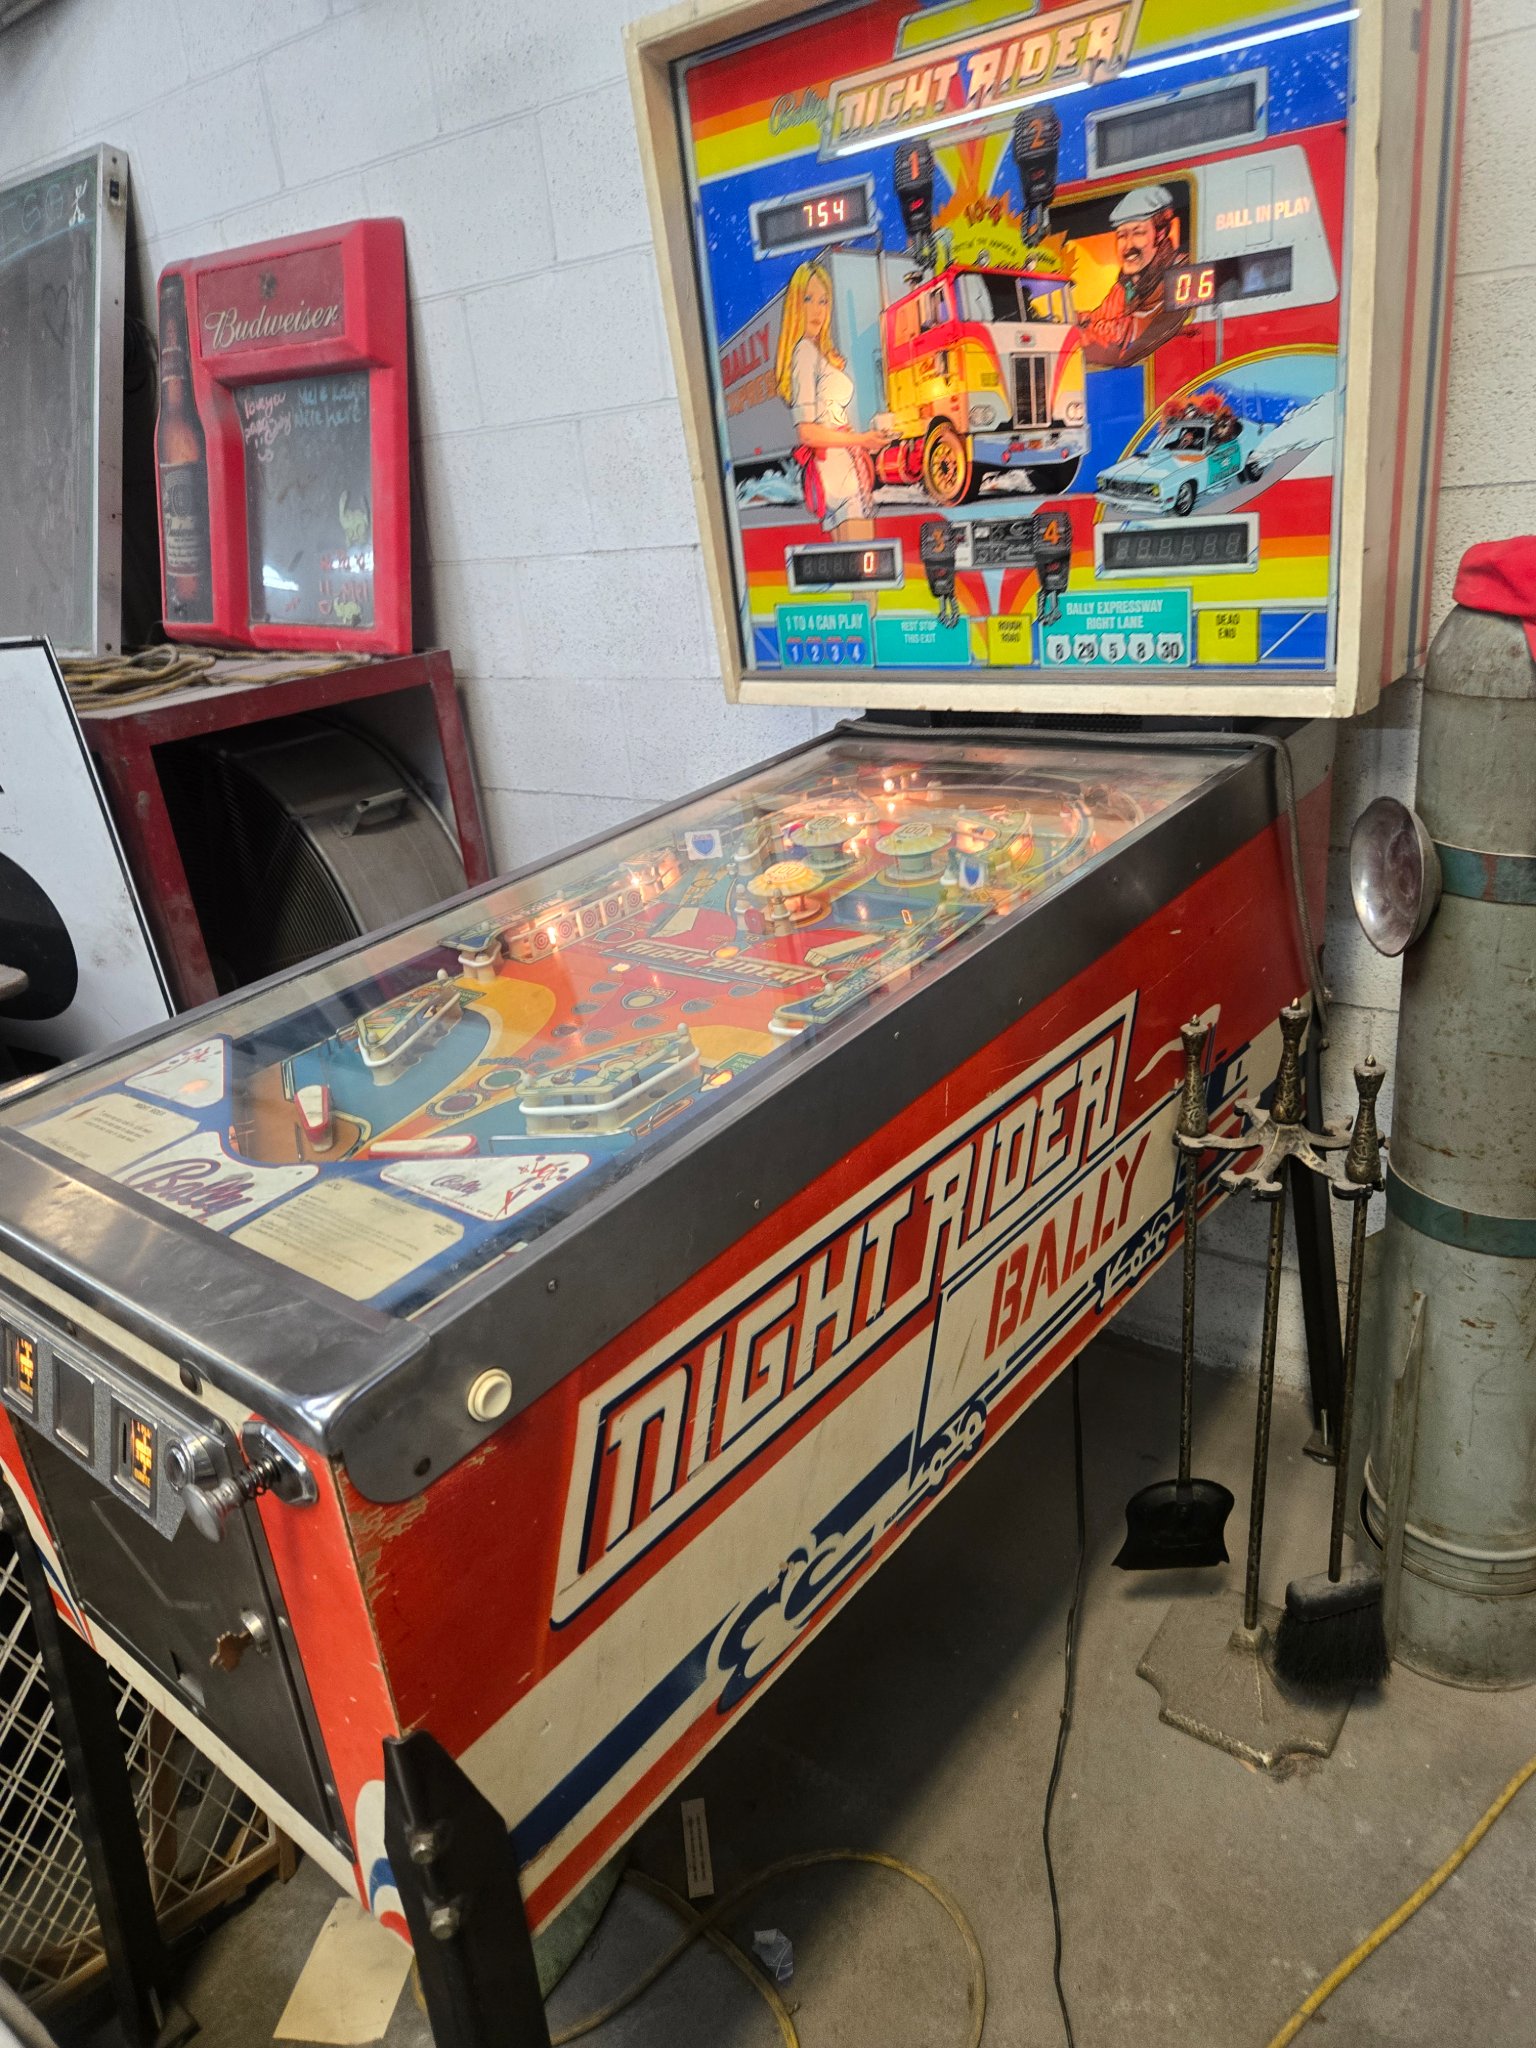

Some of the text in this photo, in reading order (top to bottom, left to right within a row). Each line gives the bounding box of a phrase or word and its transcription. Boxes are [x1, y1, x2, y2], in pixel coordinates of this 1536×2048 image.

[838, 11, 1125, 139] NIGHT RIDER
[1029, 118, 1046, 149] 2
[908, 150, 921, 181] 1
[803, 198, 845, 228] 754
[1215, 196, 1313, 232] BALL IN PLAY
[204, 299, 340, 350] Budweiser
[720, 321, 770, 389] BALLY
[932, 527, 946, 553] 3
[1042, 520, 1062, 546] 4
[863, 551, 875, 573] 0
[1066, 599, 1164, 616] BALLY EXPRESSWAY
[1215, 613, 1240, 626] DEAD
[793, 615, 806, 631] TO
[816, 614, 836, 631] CAN
[838, 613, 864, 630] PLAY
[1086, 615, 1144, 631] RIGHT LANE
[1162, 641, 1180, 660] 30
[703, 957, 806, 984] RIDER
[122, 1157, 255, 1220] Bally
[430, 1174, 482, 1197] Bally
[984, 1130, 1152, 1361] BALLY
[602, 1035, 1117, 1554] NIGHT RIDER
